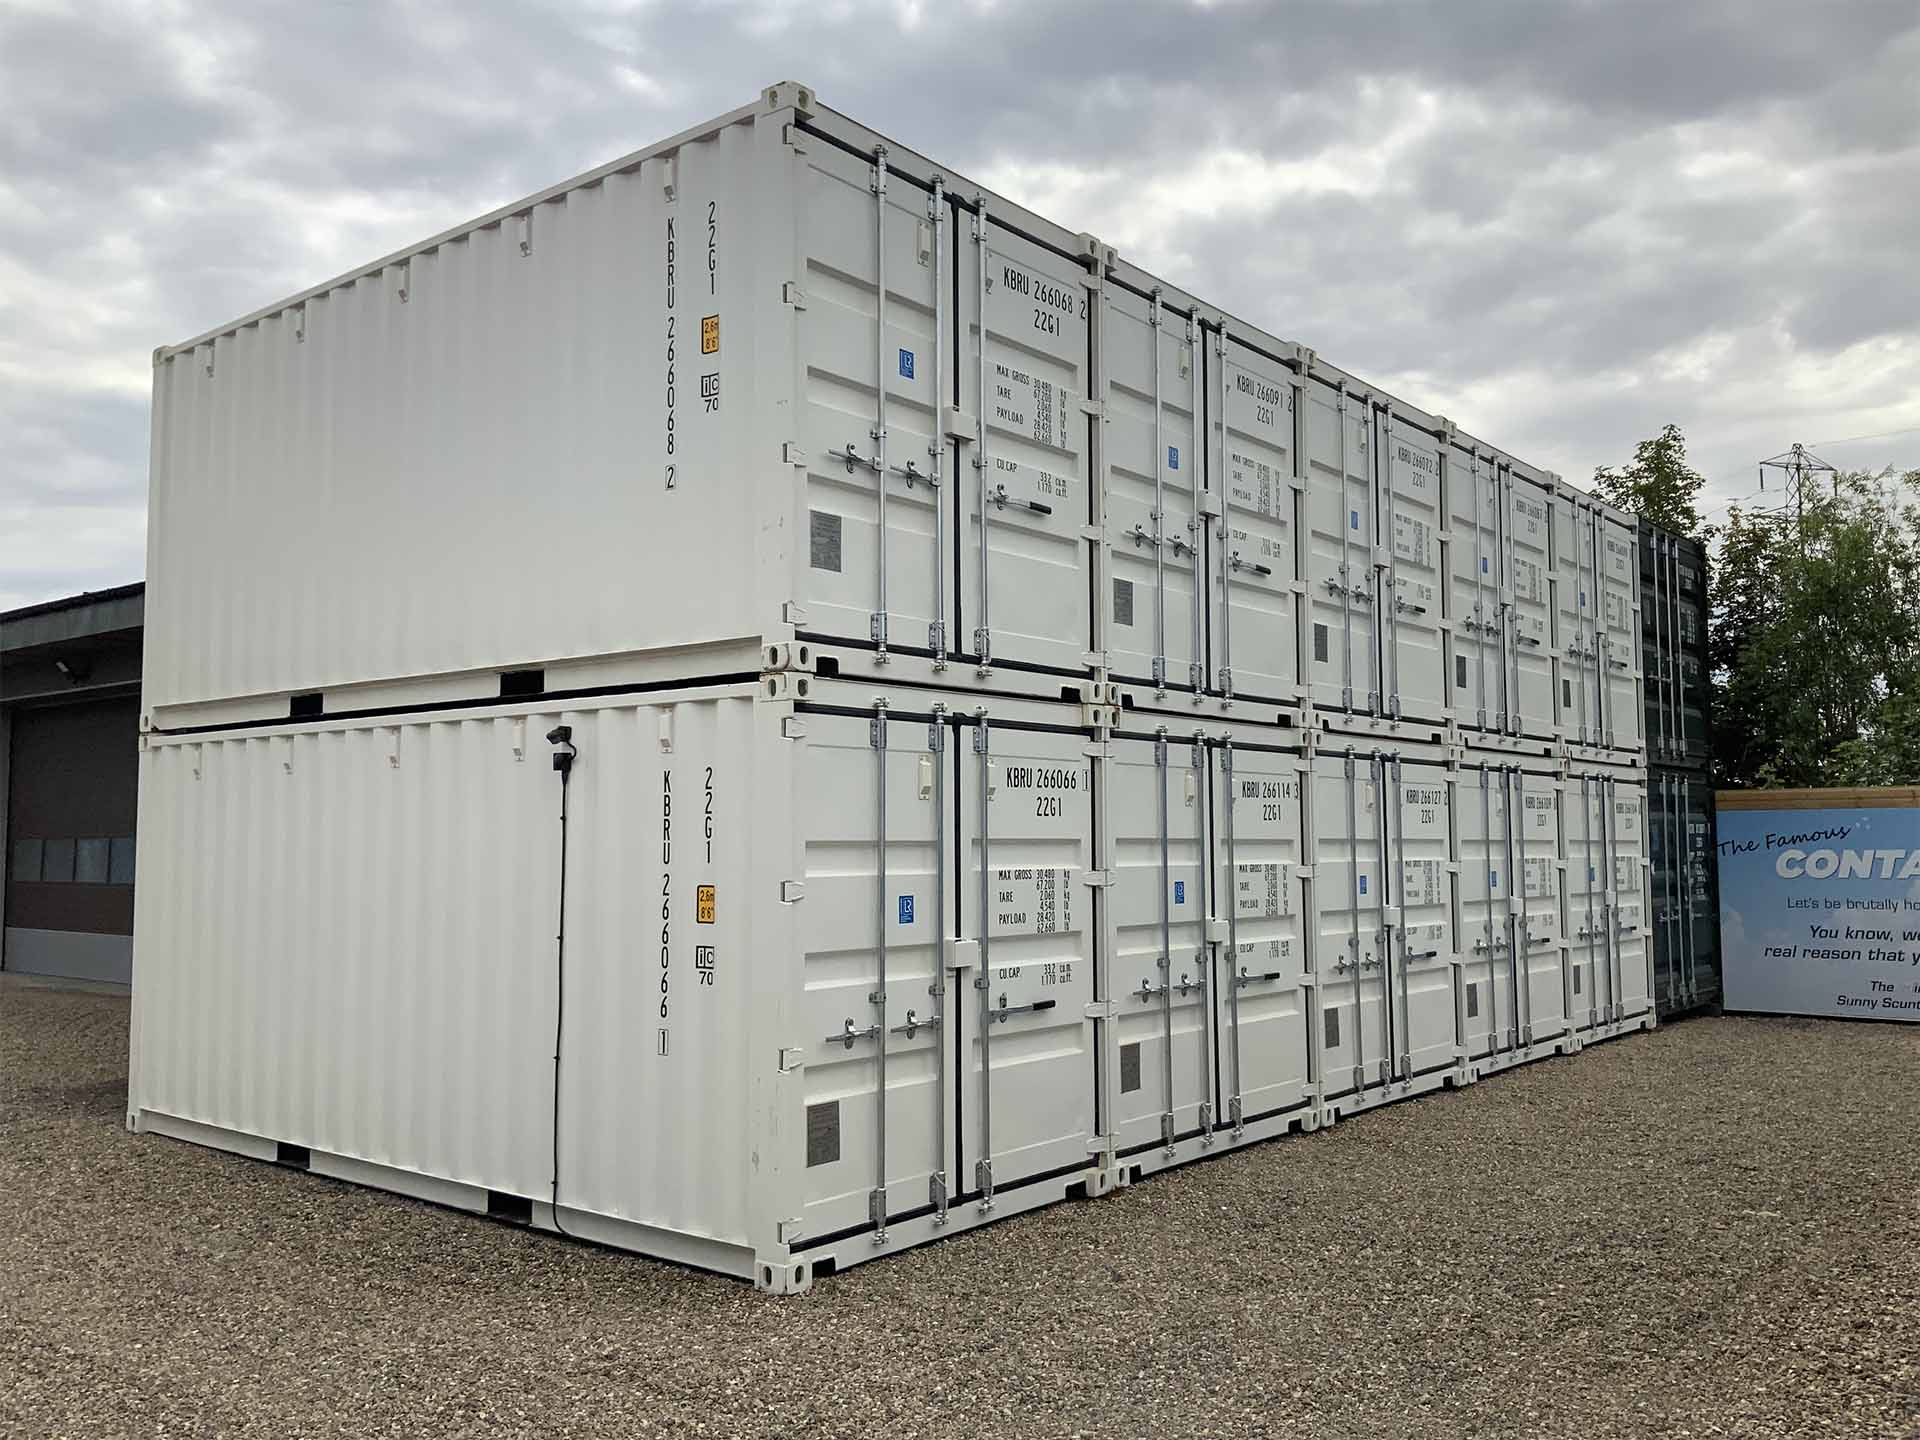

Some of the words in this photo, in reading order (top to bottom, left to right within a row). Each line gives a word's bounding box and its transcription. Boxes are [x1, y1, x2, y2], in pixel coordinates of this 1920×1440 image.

[708, 201, 716, 295] 22G1
[667, 218, 675, 309] KBRU
[1004, 266, 1029, 296] KBRU
[1034, 281, 1073, 314] 266068
[1080, 300, 1086, 320] 2
[1034, 308, 1060, 337] 22G1
[996, 364, 1010, 378] MAX
[1011, 369, 1030, 386] GROSS
[667, 316, 675, 455] 266068
[996, 385, 1012, 401] TARE
[704, 397, 719, 413] 70
[1256, 383, 1283, 409] 266091
[996, 406, 1024, 425] PAYLOAD
[1006, 767, 1033, 788] KBRU
[1036, 768, 1077, 790] 266066
[1262, 781, 1290, 799] 266114
[1294, 782, 1299, 799] 3
[704, 766, 713, 864] 22G1
[1036, 796, 1062, 817] 22G1
[1263, 803, 1281, 821] 22G1
[663, 769, 672, 865] KBRU
[1717, 839, 1760, 857] The
[1766, 826, 1852, 850] Famous
[998, 869, 1012, 881] MAX
[1014, 868, 1033, 881] GROSS
[999, 891, 1014, 903] TARE
[1787, 897, 1820, 910] Let's
[1824, 897, 1841, 910] be
[1846, 897, 1899, 913] brutally
[998, 912, 1027, 925] PAYLOAD
[1810, 925, 1839, 939] You
[1845, 926, 1894, 943] know,
[660, 873, 671, 1019] 266066
[1764, 945, 1797, 958] real
[1802, 948, 1861, 960] reason
[1868, 948, 1905, 962] that
[699, 971, 713, 986] 70
[1870, 980, 1895, 993] The
[1836, 995, 1879, 1010] Sunny
